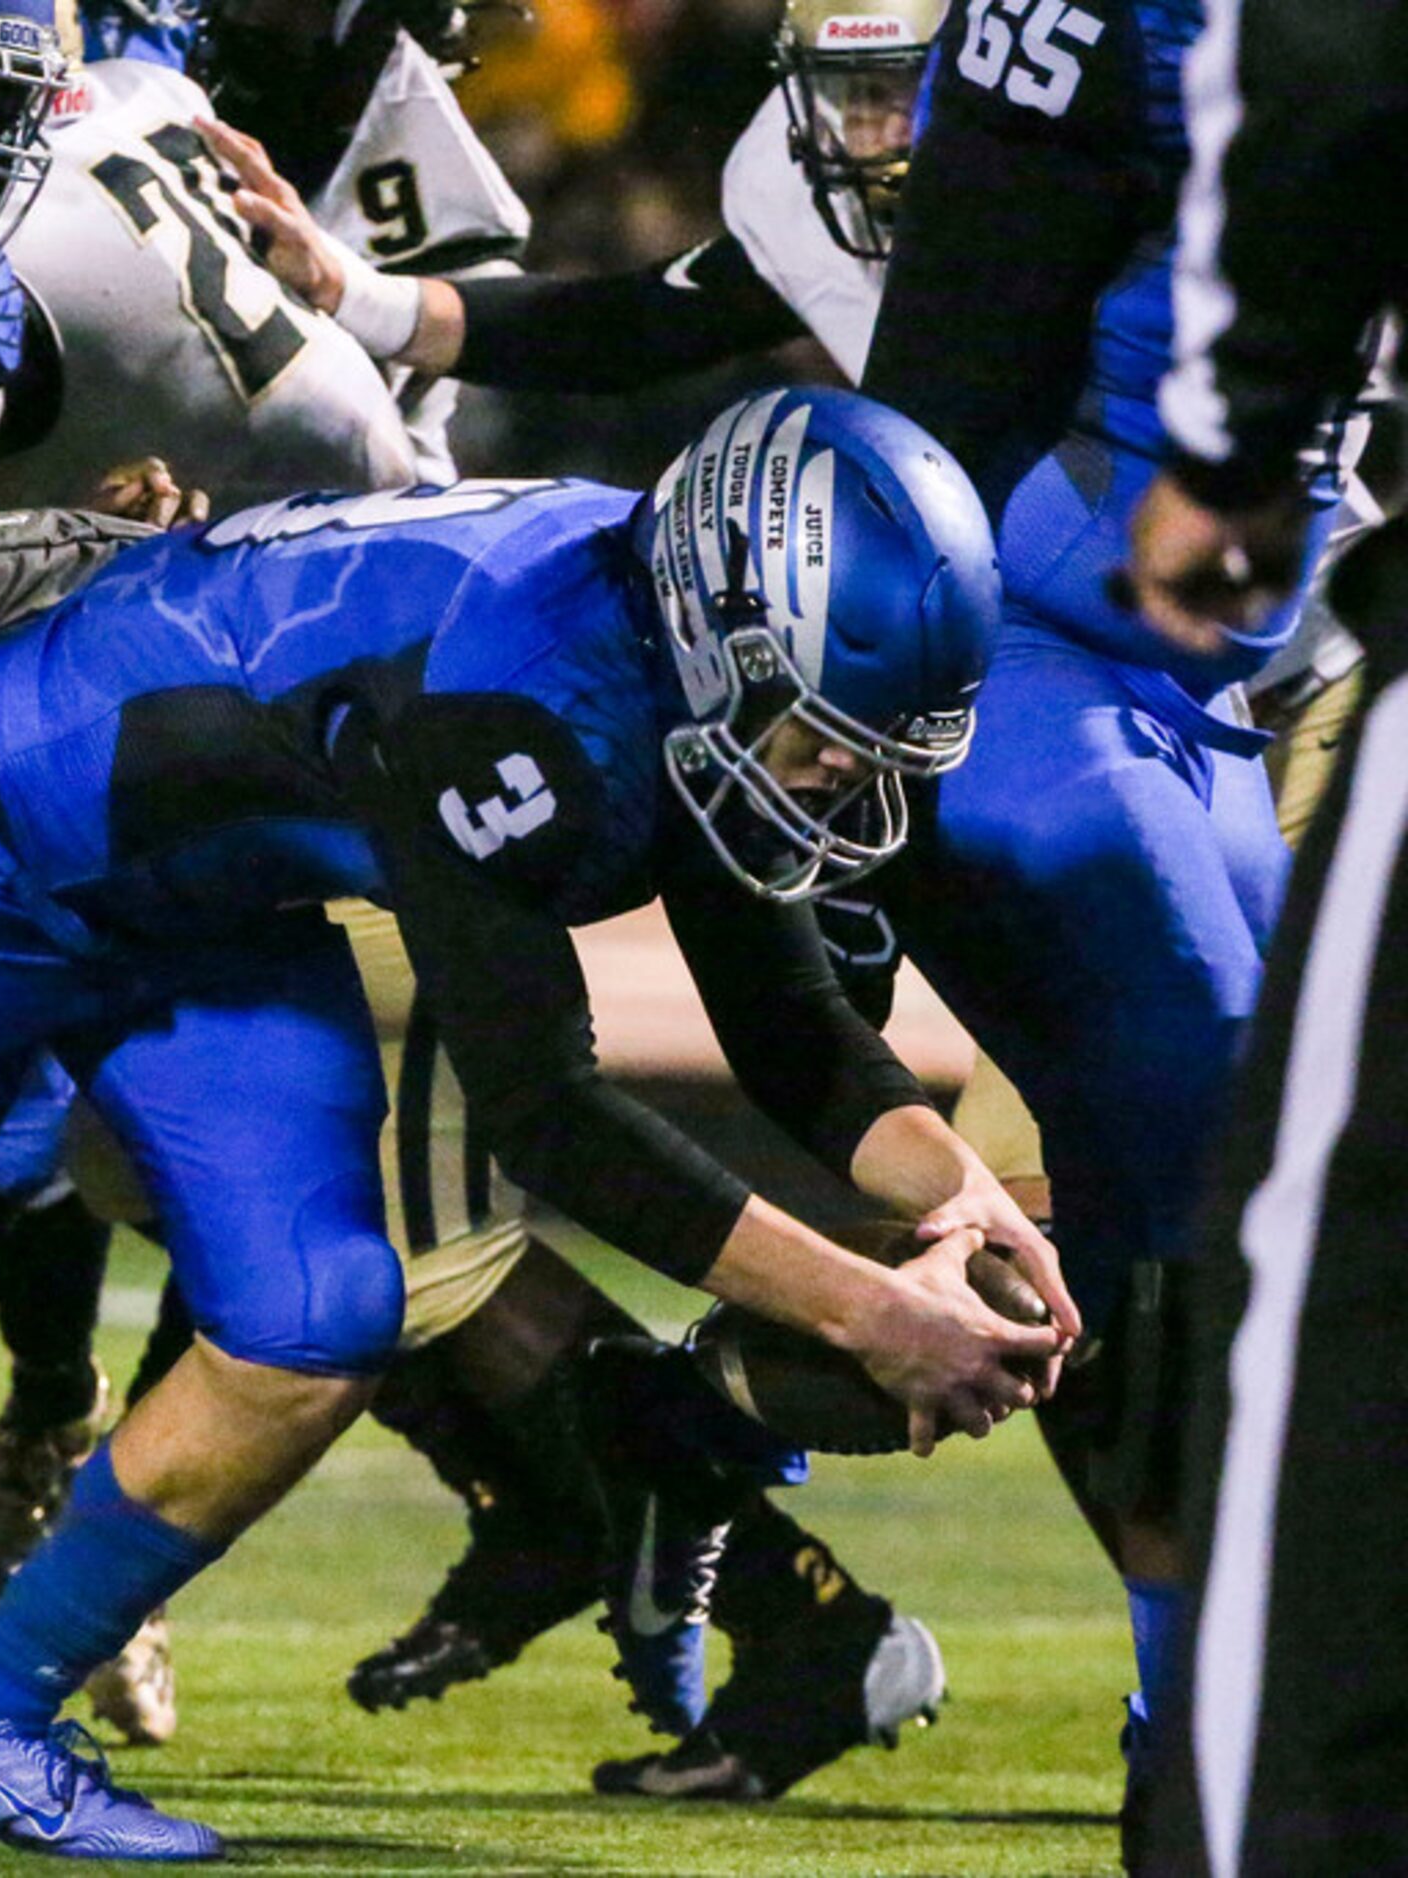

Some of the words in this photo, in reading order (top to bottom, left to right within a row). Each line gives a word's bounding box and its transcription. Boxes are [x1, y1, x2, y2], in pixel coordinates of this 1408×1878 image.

[828, 22, 900, 39] Riddell
[956, 0, 1106, 119] 65
[357, 158, 428, 256] 9
[729, 442, 751, 508] TOUGH
[767, 455, 788, 550] COMPETE
[805, 502, 823, 567] JUICE
[438, 752, 557, 861] 3
